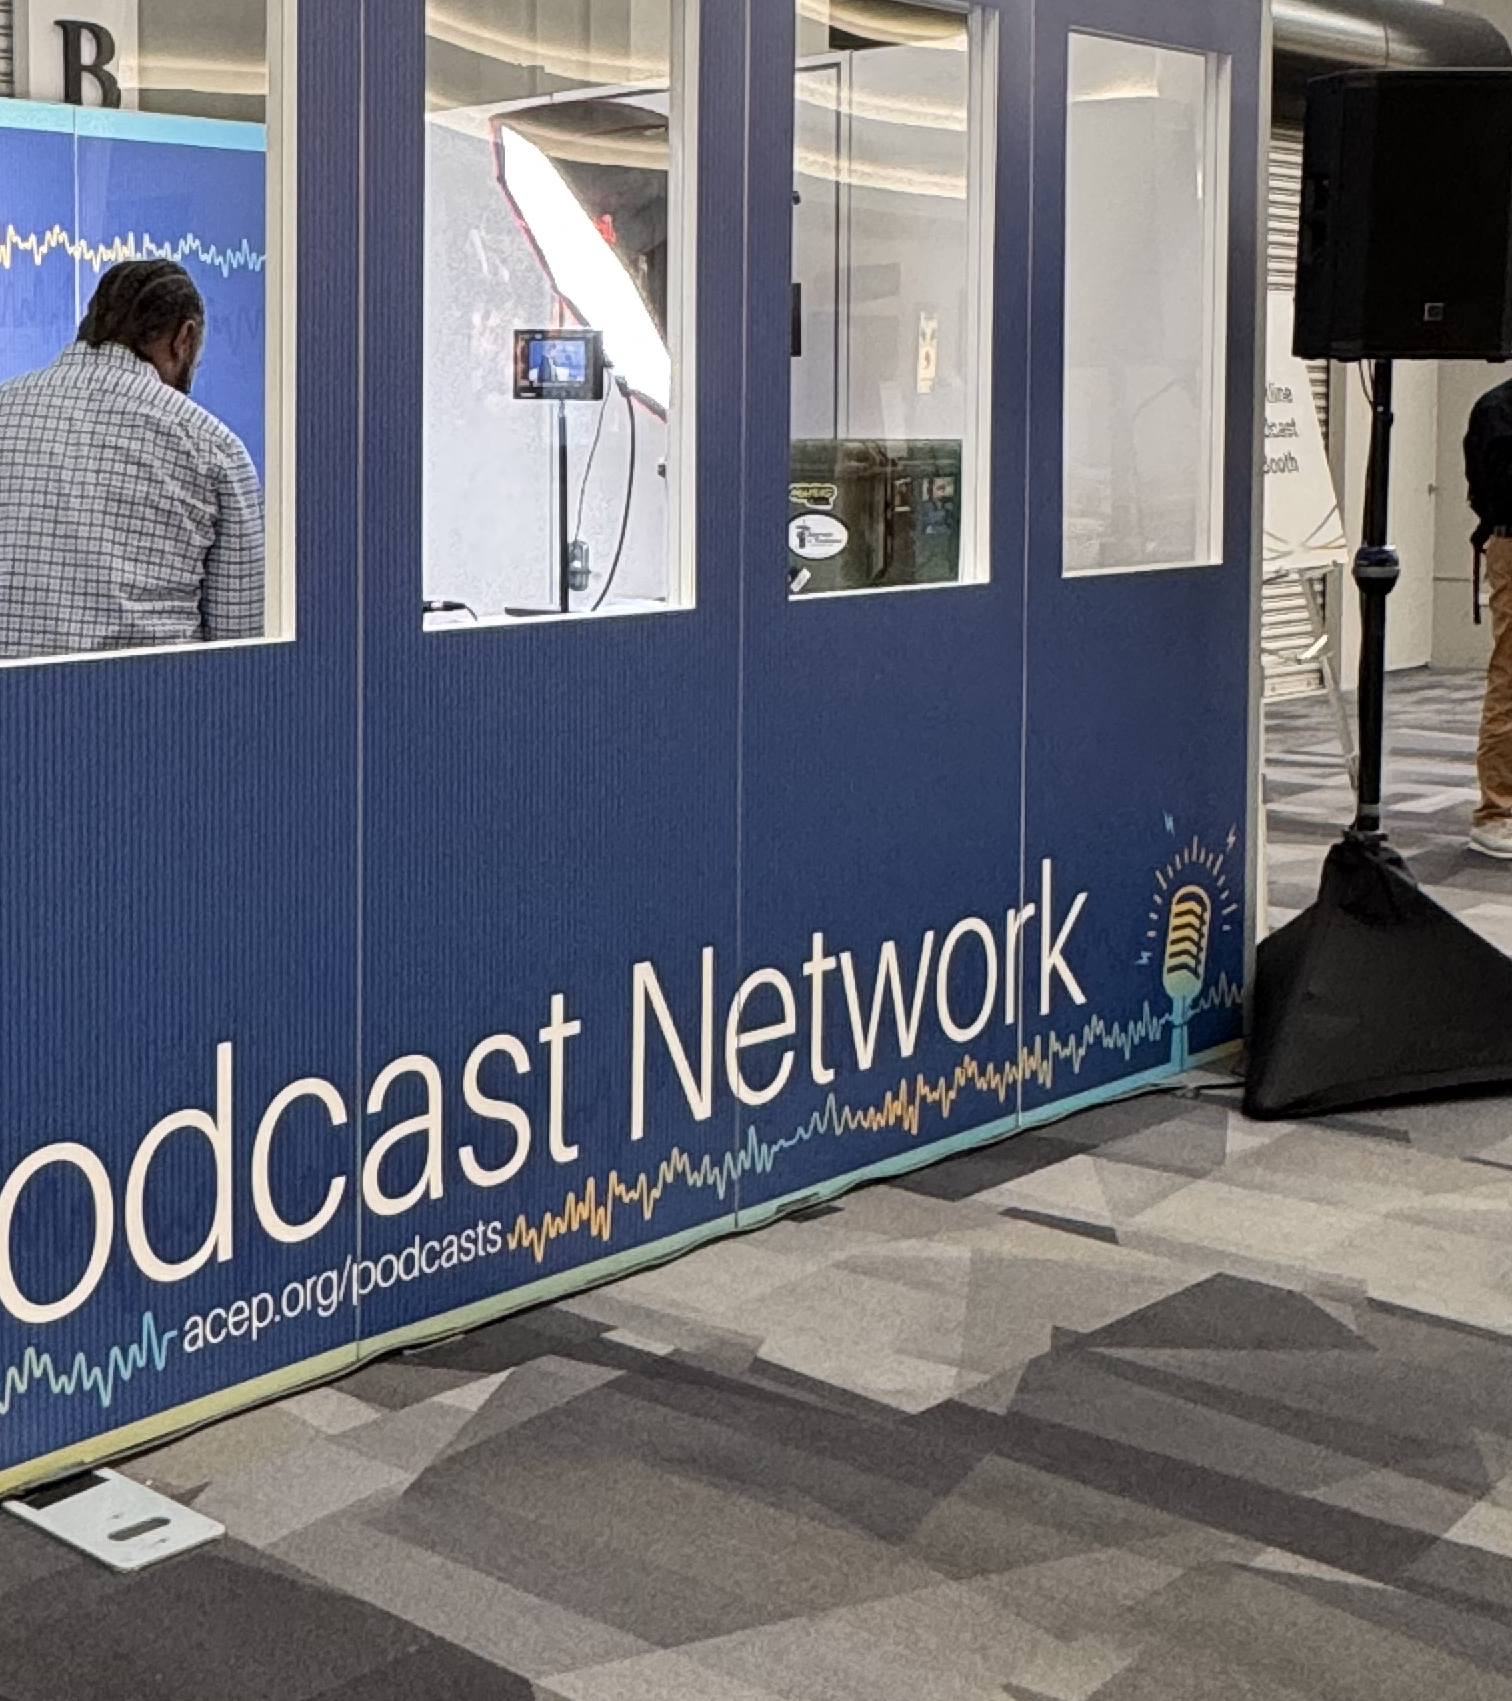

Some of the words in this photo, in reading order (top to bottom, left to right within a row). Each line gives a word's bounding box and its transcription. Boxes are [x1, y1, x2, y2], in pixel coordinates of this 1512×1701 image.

[54, 19, 121, 108] B
[630, 858, 1089, 1141] Network
[182, 1219, 503, 1353] acep.org/podcasts
